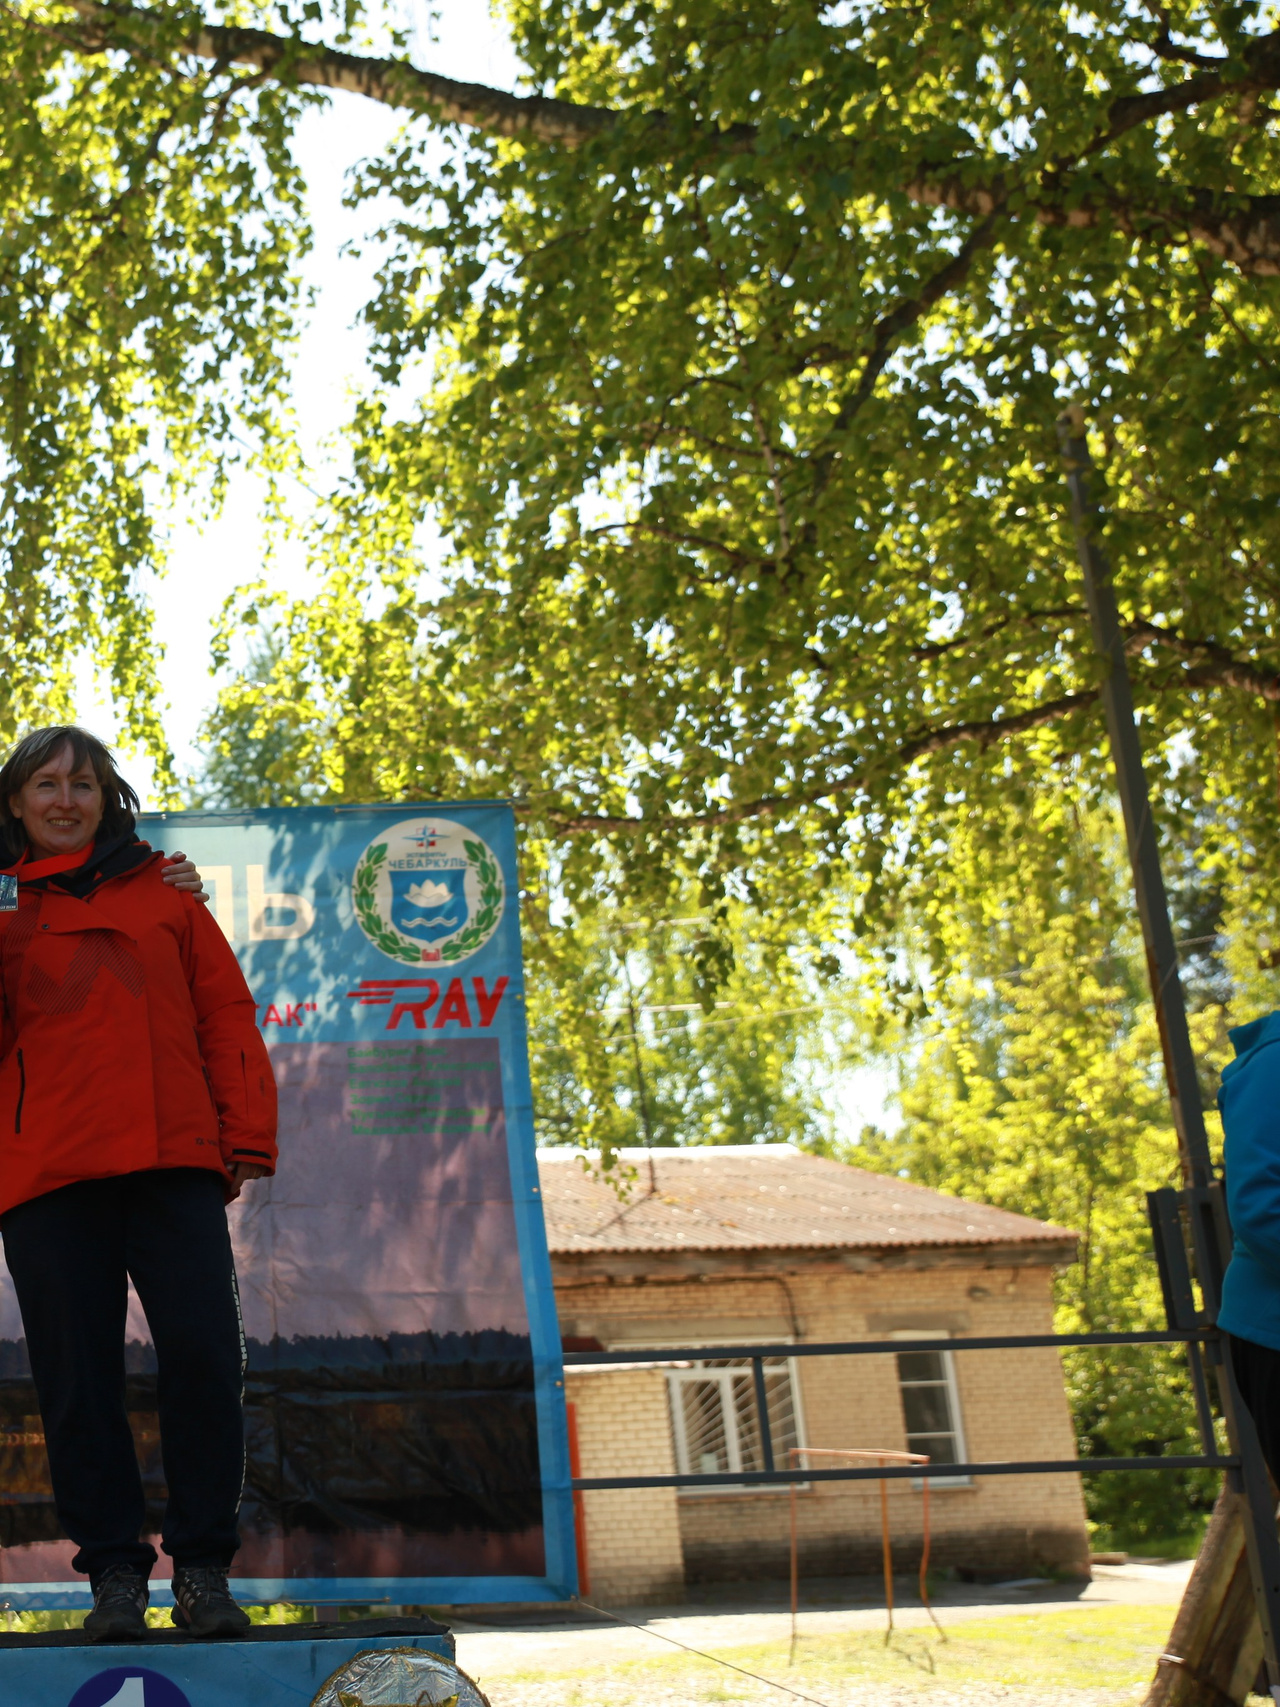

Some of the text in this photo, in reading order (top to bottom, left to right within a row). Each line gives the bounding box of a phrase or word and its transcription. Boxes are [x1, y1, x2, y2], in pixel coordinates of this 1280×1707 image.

[388, 857, 468, 869] ЧЕБАРКУЛЬ
[255, 1002, 317, 1028] АК"
[347, 976, 510, 1030] RAY
